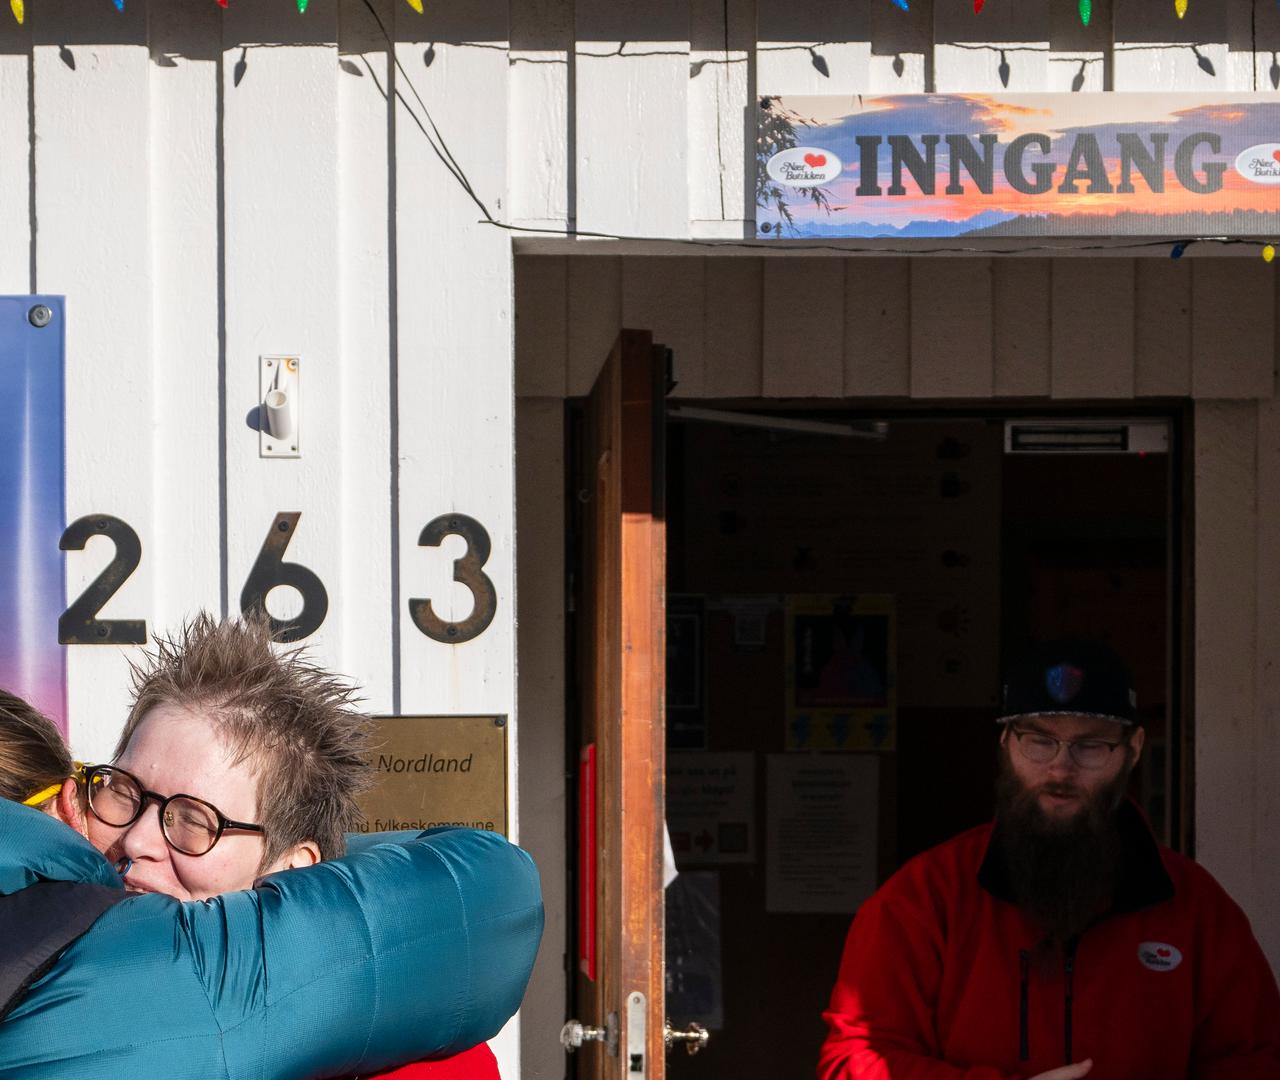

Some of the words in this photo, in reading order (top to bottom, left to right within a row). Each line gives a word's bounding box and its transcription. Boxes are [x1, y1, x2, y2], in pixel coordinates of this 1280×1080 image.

[779, 161, 806, 173] Nær
[855, 131, 1229, 197] INNGANG
[1248, 158, 1275, 170] Nær
[785, 171, 826, 181] Butikken
[377, 753, 473, 774] Nordland
